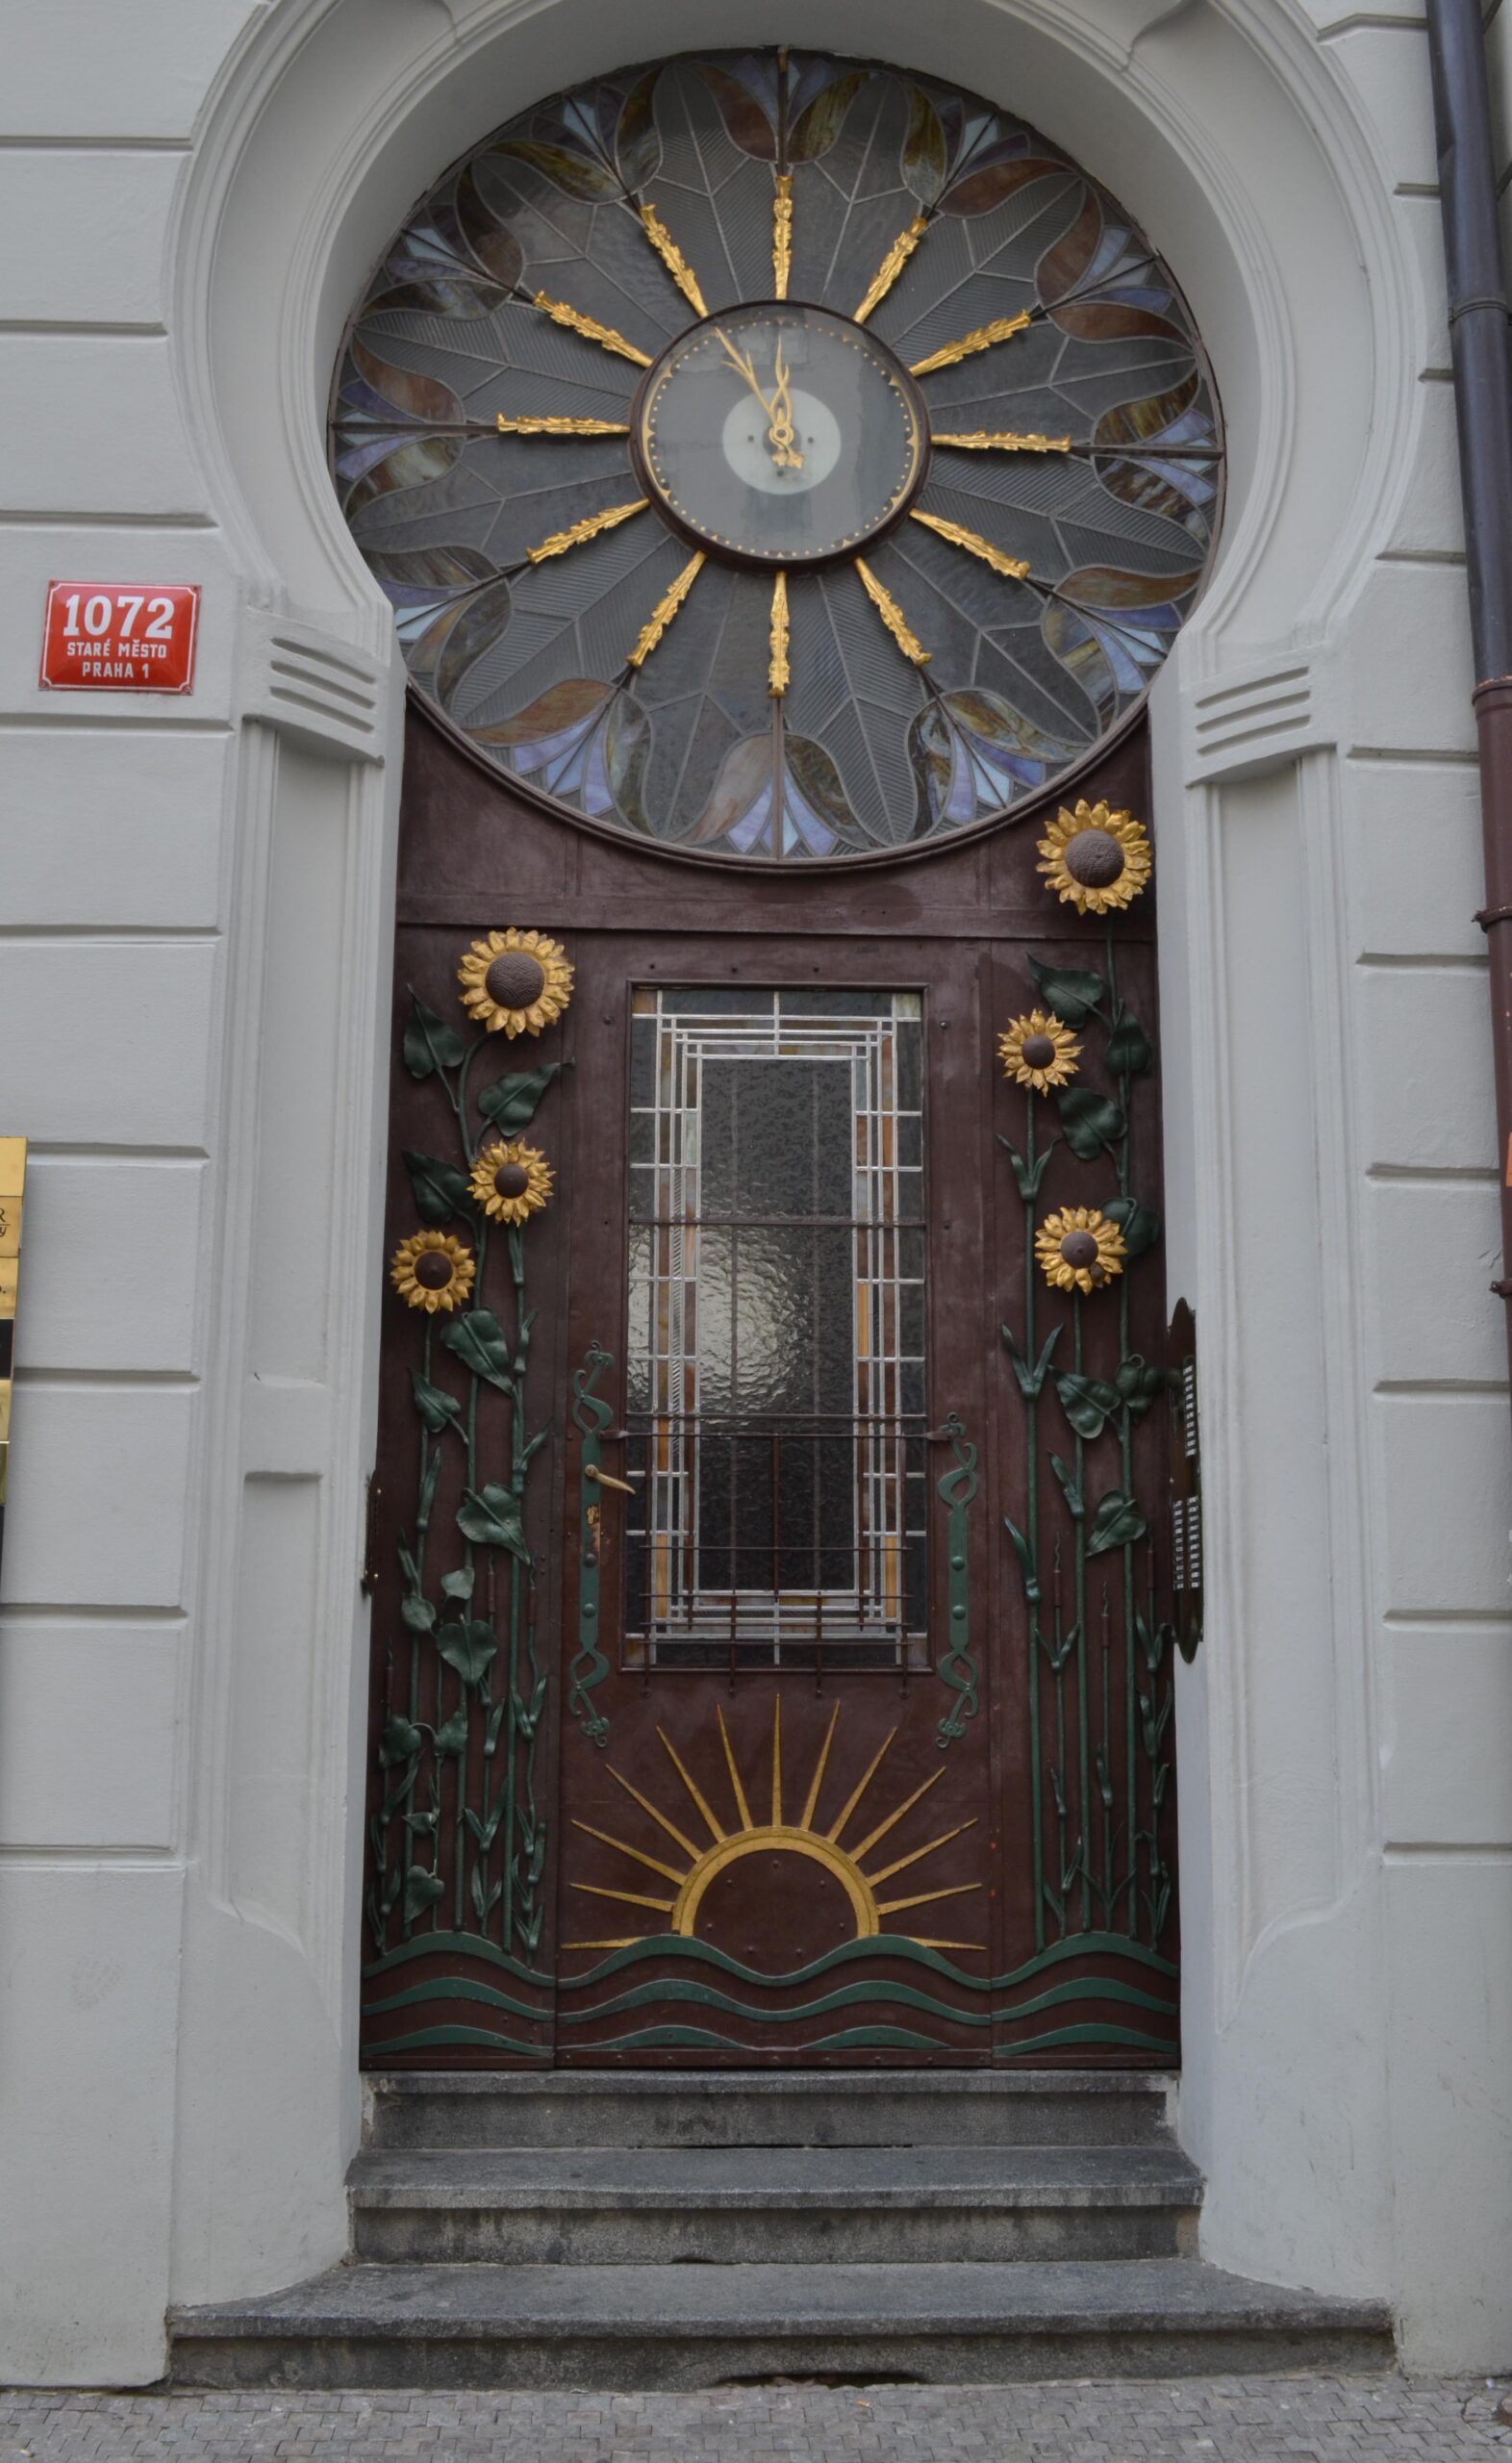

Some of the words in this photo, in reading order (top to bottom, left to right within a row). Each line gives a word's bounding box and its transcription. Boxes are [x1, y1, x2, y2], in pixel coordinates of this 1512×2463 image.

[63, 595, 175, 639] 1072
[67, 639, 111, 656] STARÉ
[118, 639, 166, 658] MĚSTO
[82, 661, 134, 677] PRAHA
[141, 663, 149, 678] 1
